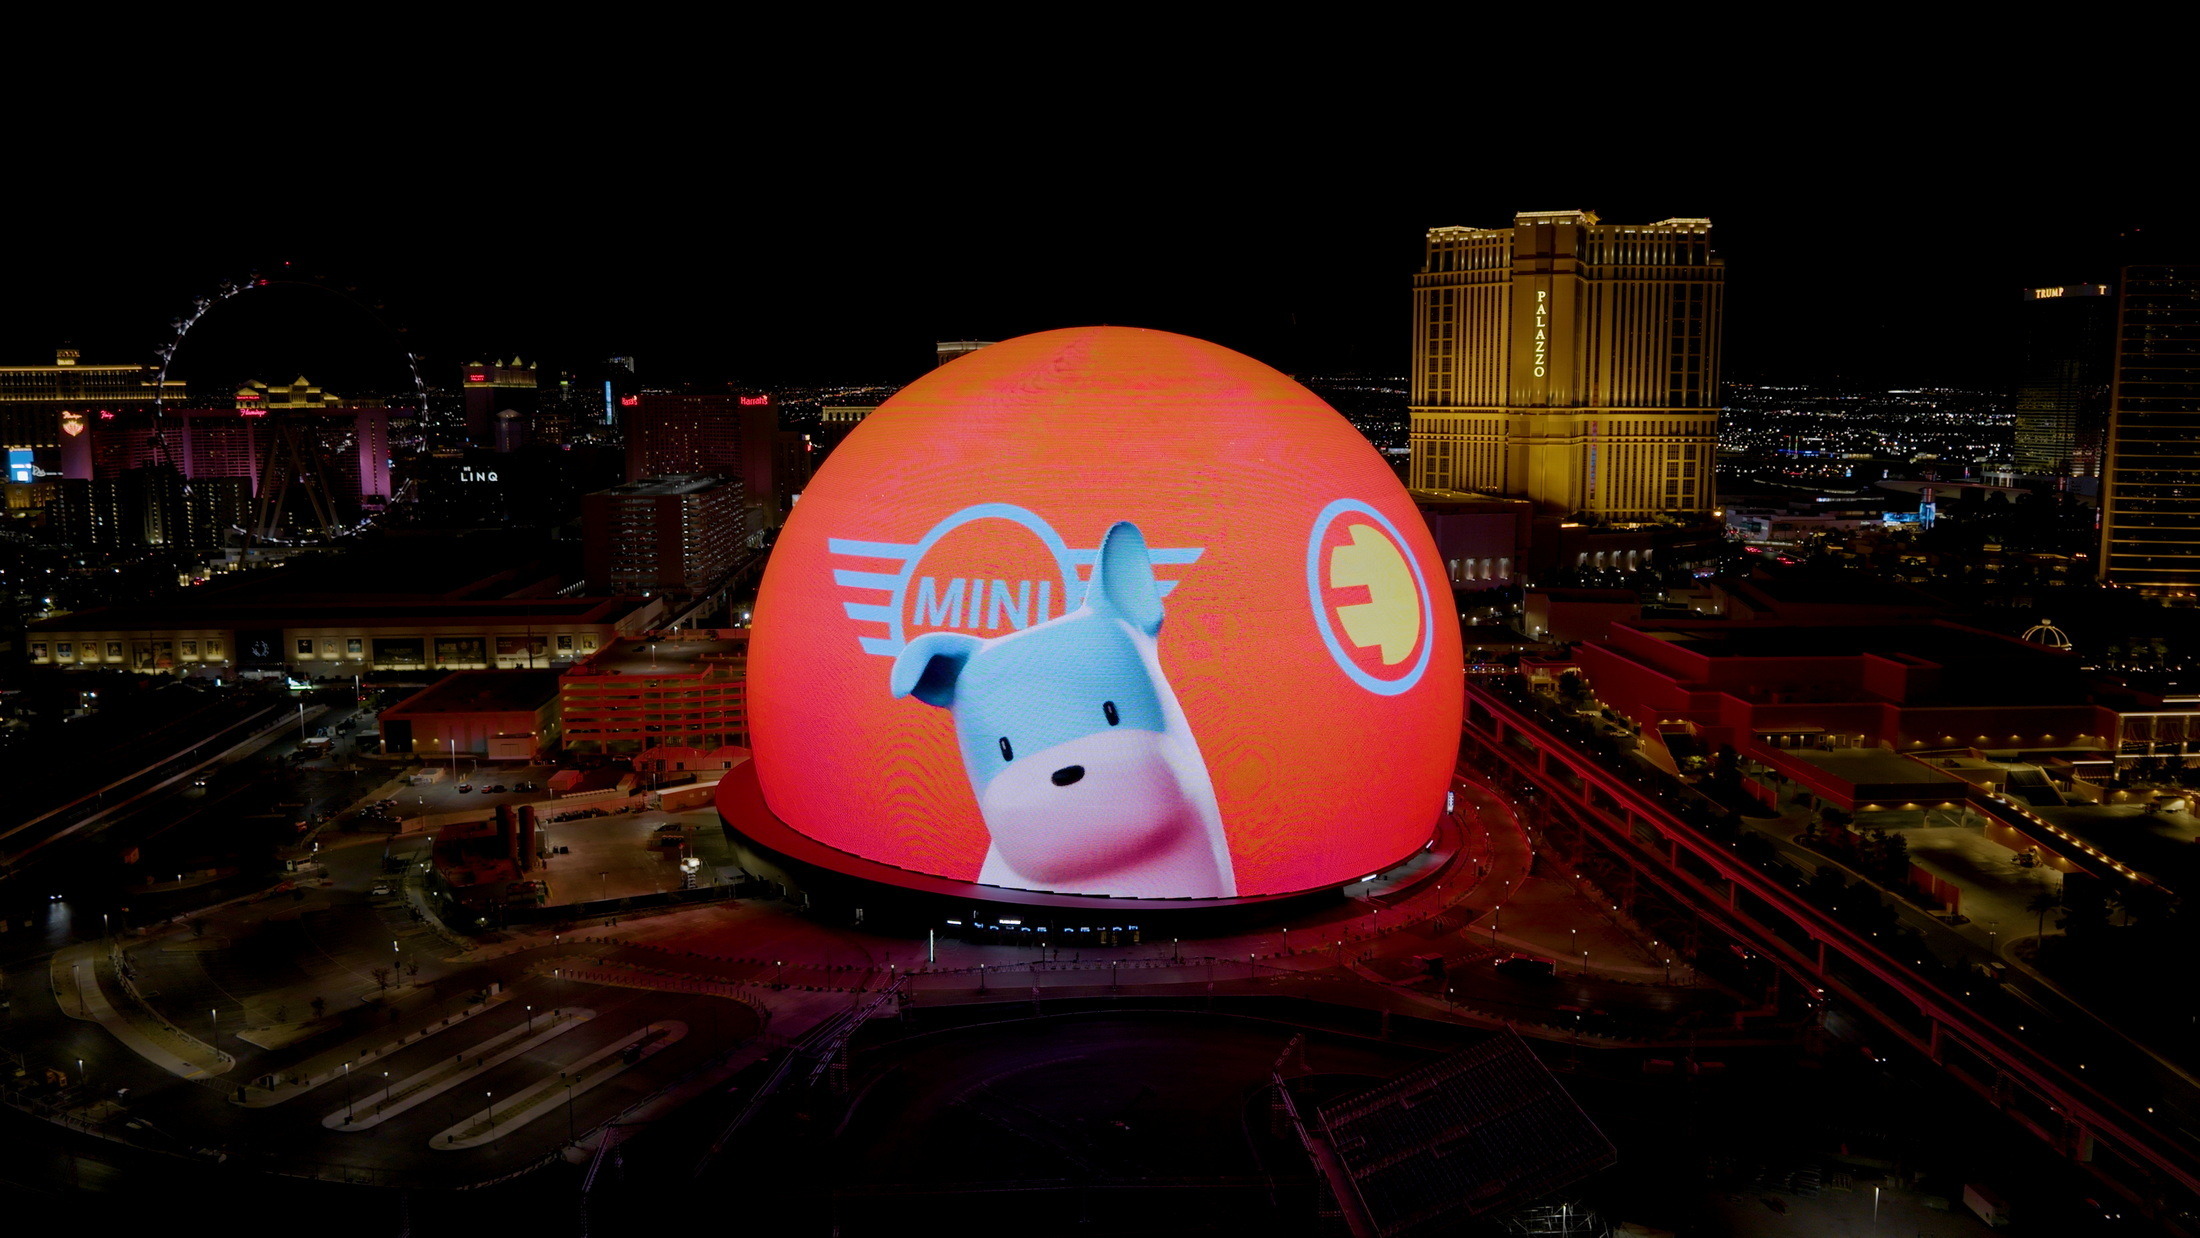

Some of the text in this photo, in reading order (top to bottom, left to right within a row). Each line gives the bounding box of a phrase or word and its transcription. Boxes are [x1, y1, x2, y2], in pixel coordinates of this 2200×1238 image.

[2035, 286, 2065, 299] TRUMP
[1533, 290, 1547, 378] PALAZZO
[240, 408, 267, 417] Flamingo
[460, 471, 498, 482] LINQ
[912, 576, 1052, 630] MINI
